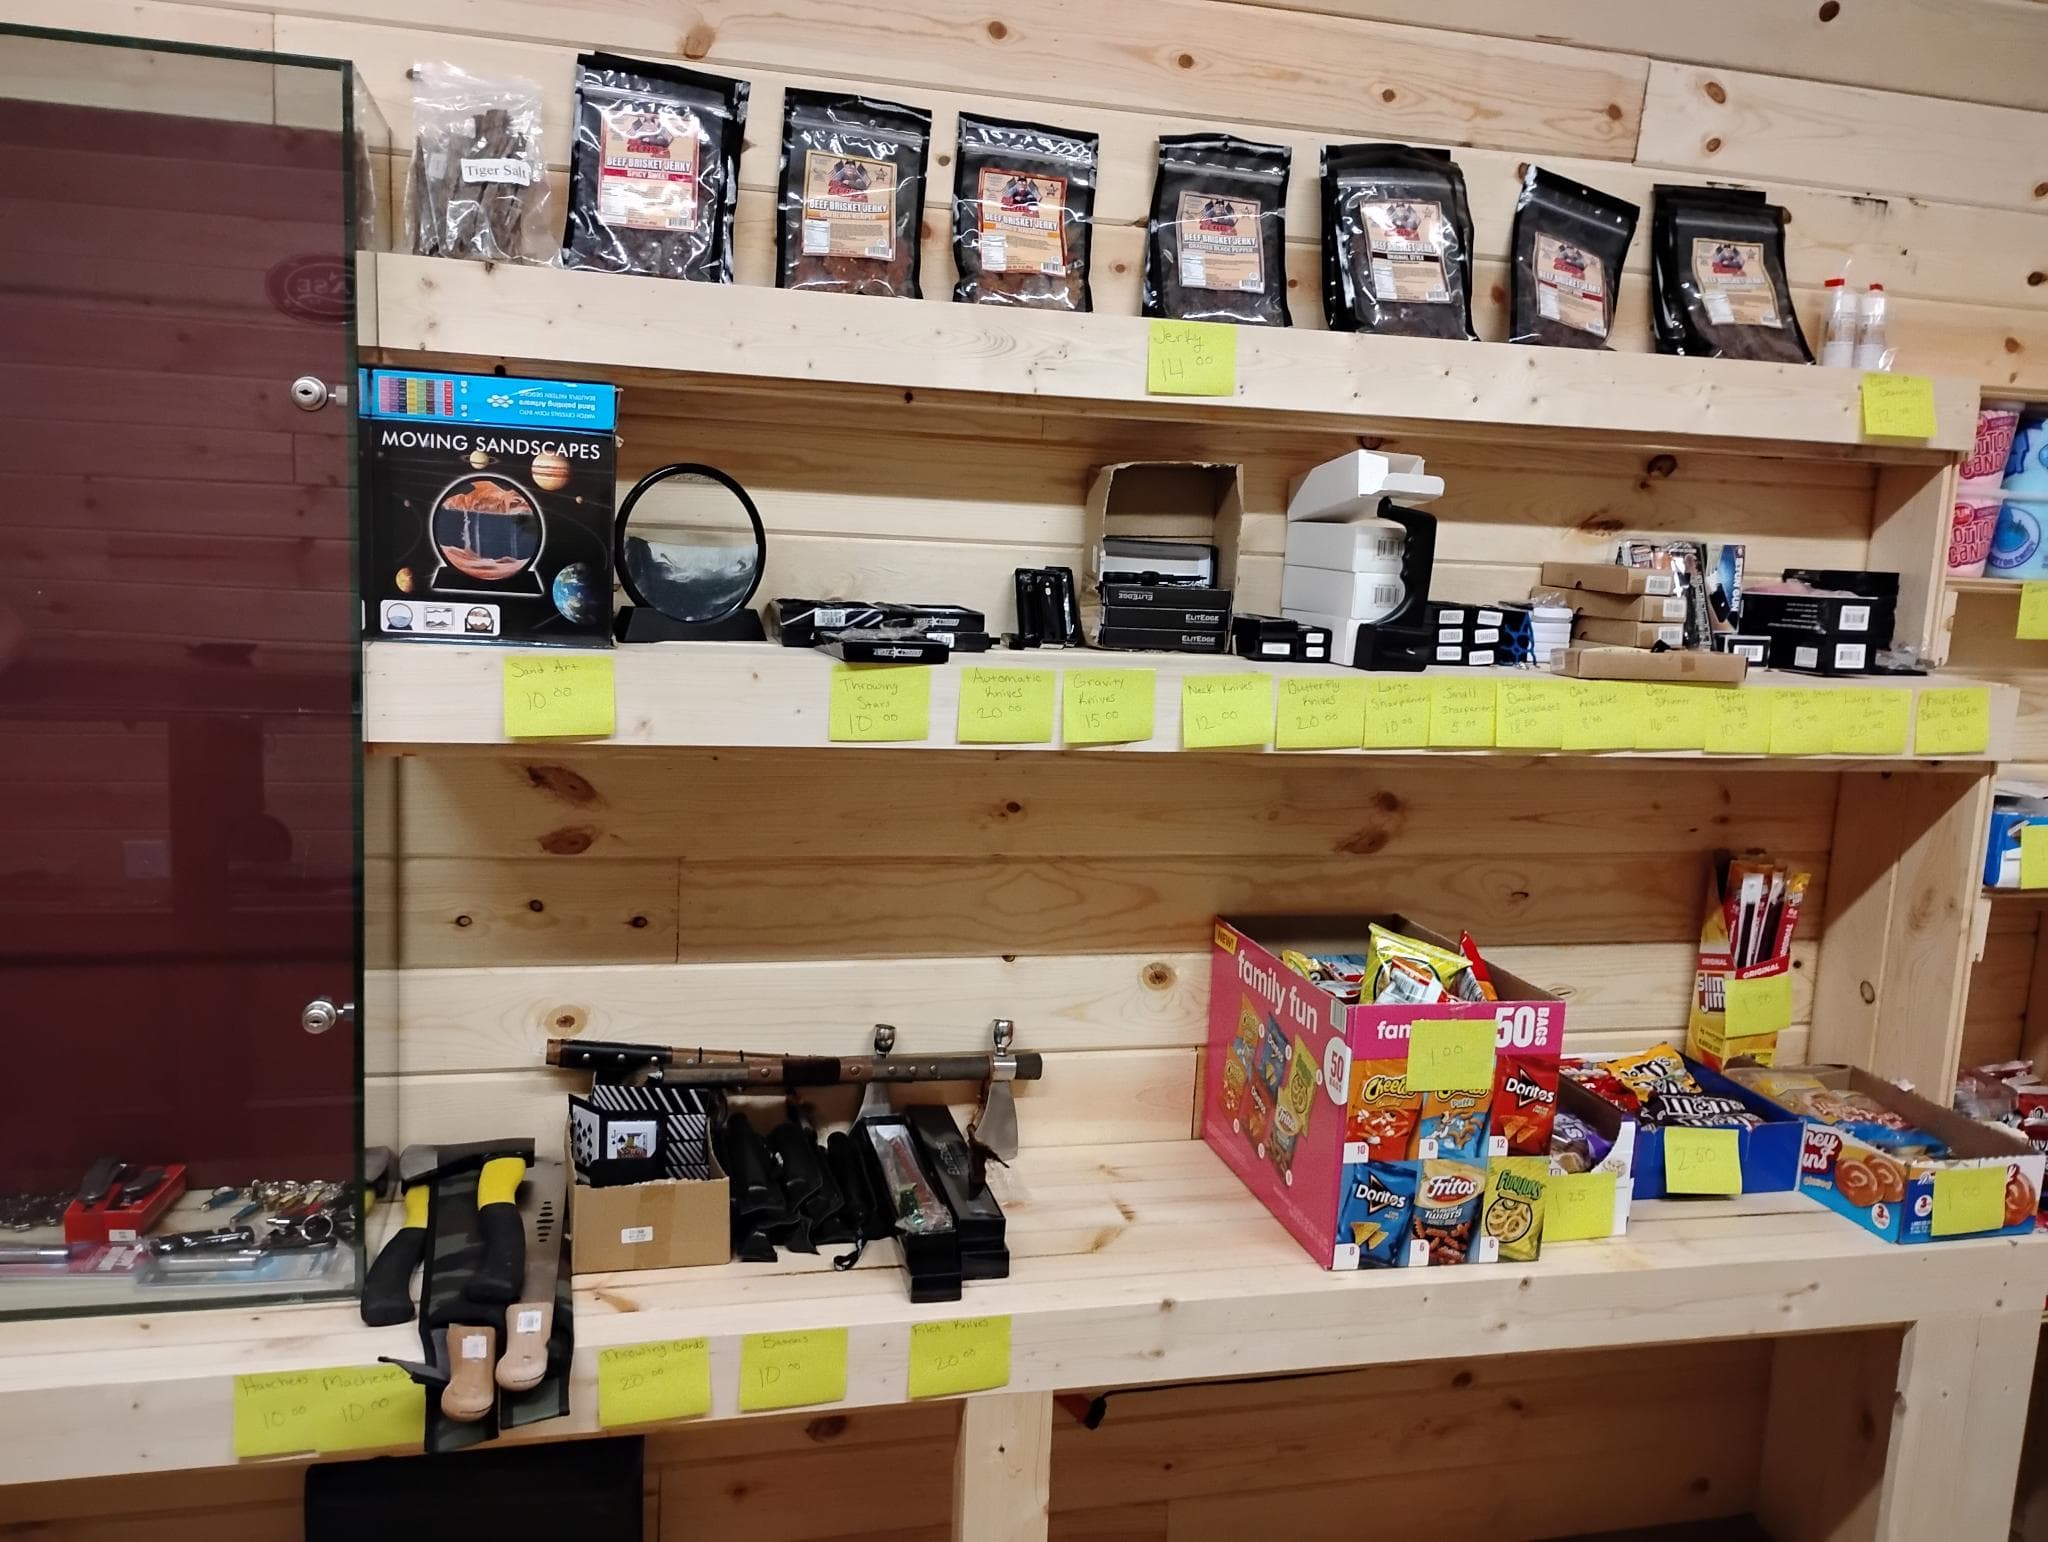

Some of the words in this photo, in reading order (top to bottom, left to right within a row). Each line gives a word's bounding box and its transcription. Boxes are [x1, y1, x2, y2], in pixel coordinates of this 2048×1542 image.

[465, 165, 499, 177] Tiger
[503, 164, 526, 179] Salt
[607, 157, 627, 167] BEEF
[628, 159, 664, 170] BRISKET
[665, 160, 691, 172] JERKY
[809, 199, 828, 209] BEEF
[829, 201, 861, 212] BRISKET
[863, 203, 887, 213] JERKY
[1003, 215, 1033, 228] BRISKET
[1035, 219, 1057, 231] JERKY
[1184, 233, 1200, 243] BEEF
[1202, 235, 1231, 246] BRISKET
[1233, 236, 1257, 247] JERKY
[1153, 325, 1205, 353] Jerky
[1161, 358, 1183, 382] 14
[382, 430, 468, 450] MOVING
[476, 437, 600, 459] SANDSCAPES
[511, 662, 544, 678] Sand
[554, 659, 580, 672] Art
[972, 668, 1041, 684] Automatic
[840, 678, 898, 695] Throwing
[1073, 674, 1124, 689] Gravity
[1188, 684, 1213, 695] Neck
[526, 692, 547, 711] 10
[857, 698, 890, 709] Stars
[976, 708, 1002, 719] 20
[1086, 713, 1100, 728] 15
[850, 712, 872, 734] 10
[1196, 716, 1216, 730] 12
[1742, 963, 1780, 979] ORIGINAL
[1238, 949, 1287, 1015] family
[1289, 986, 1318, 1034] fun
[1495, 1006, 1536, 1048] 50
[1535, 1007, 1550, 1047] BAGS
[1331, 1051, 1344, 1083] 50
[1505, 1077, 1555, 1103] Doritos
[1497, 1139, 1505, 1148] 12
[1356, 1183, 1406, 1207] Doritos
[1427, 1175, 1477, 1198] Fritos
[1920, 1197, 1927, 1208] 3
[601, 1344, 667, 1363] Throwing
[620, 1375, 644, 1391] 20
[760, 1366, 780, 1388] 10
[264, 1411, 286, 1430] 10
[342, 1403, 364, 1423] 10
